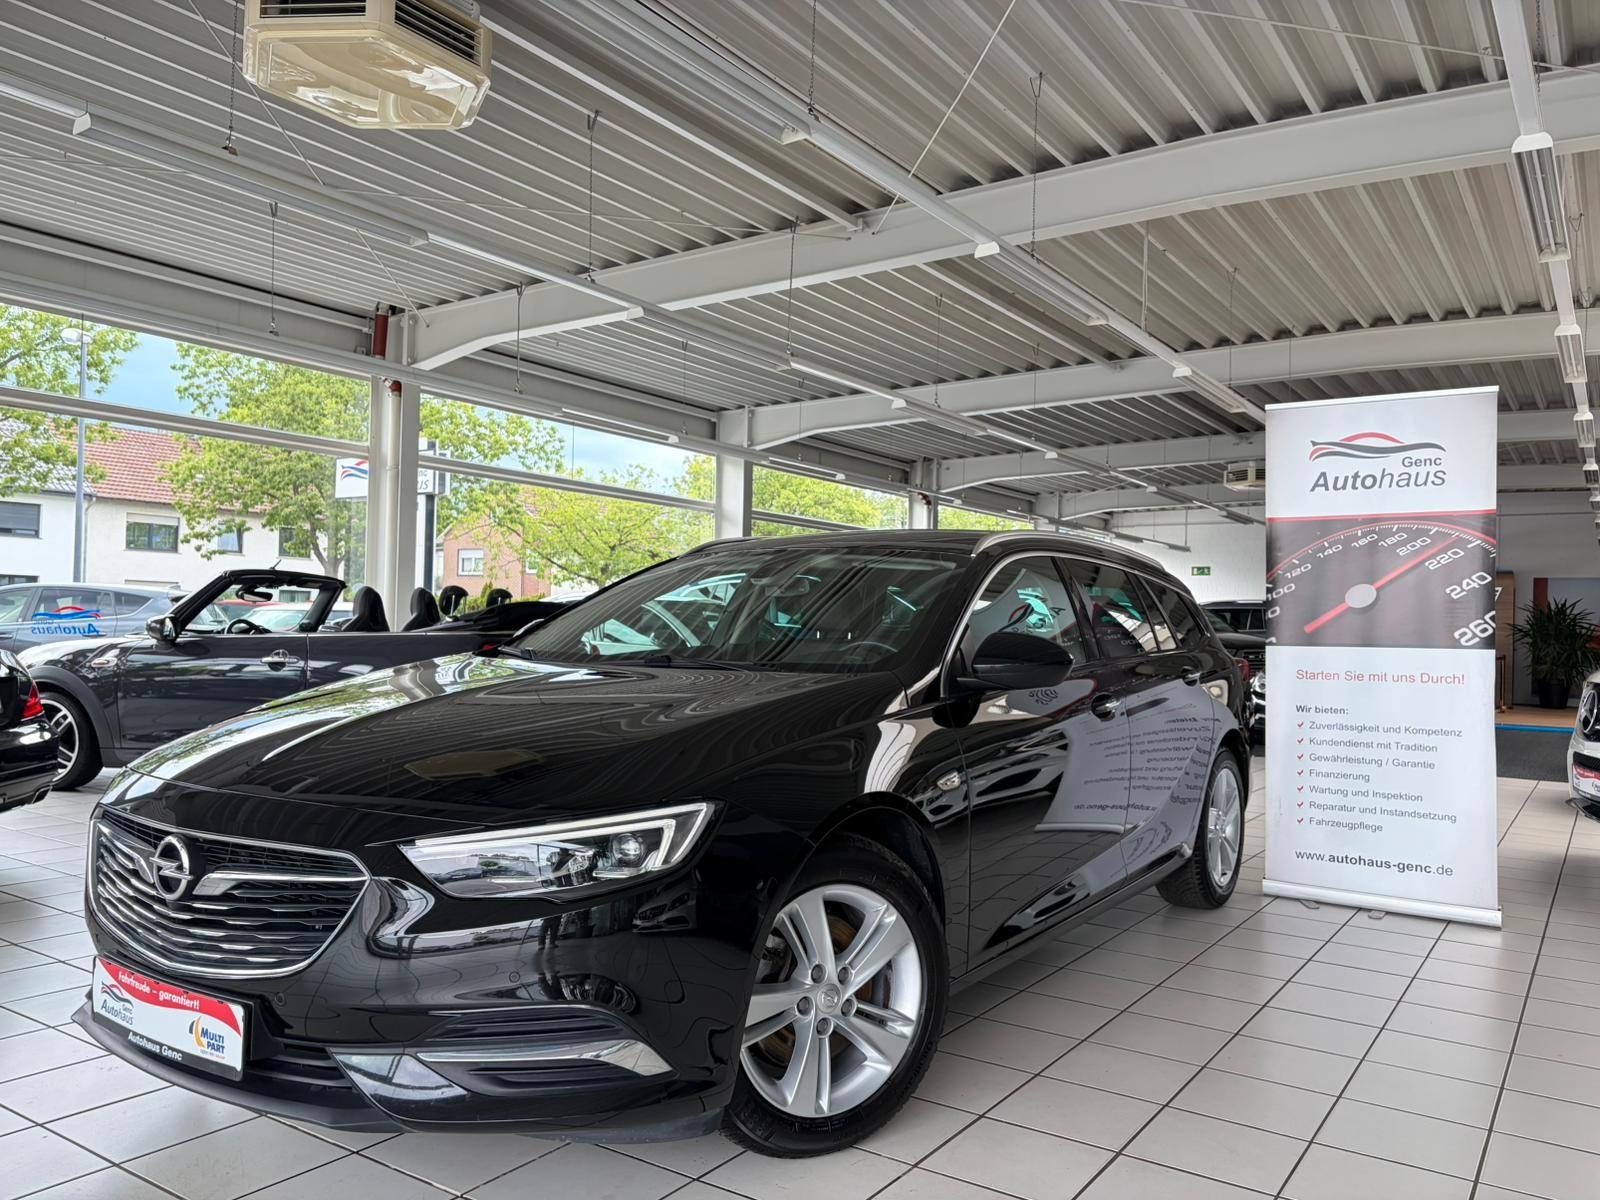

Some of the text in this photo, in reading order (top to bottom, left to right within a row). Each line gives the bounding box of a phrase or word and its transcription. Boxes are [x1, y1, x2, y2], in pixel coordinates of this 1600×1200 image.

[1401, 456, 1443, 468] Genc
[1309, 468, 1447, 493] Autohaus
[1351, 533, 1378, 548] 160
[1378, 532, 1408, 547] 180
[1396, 536, 1432, 556] 200
[1316, 544, 1343, 559] 140
[1424, 548, 1465, 570] 220
[1284, 563, 1312, 579] 120
[1266, 583, 1296, 600] 100
[1445, 571, 1492, 600] 240
[1296, 669, 1465, 685] Starten Sie mit uns Durch!
[1295, 705, 1349, 715] Wir bieten:
[1309, 721, 1463, 738] Zuverlässigkeit und Kompetenz
[1309, 737, 1438, 752] Kundendienst mit Tradition
[1309, 753, 1383, 768] Gewährleistung
[1391, 758, 1436, 770] Garantie
[1309, 769, 1370, 783] Finanzierung
[1309, 785, 1423, 802] Wartung und Inspektion
[1309, 801, 1457, 824] Reparatur und Instandsetzung
[1309, 817, 1383, 833] Fahrzeugpflege
[1295, 850, 1453, 877] www.autohaus-genc.de
[159, 990, 200, 1011] garantiert!
[101, 999, 134, 1026] Autohaus
[201, 1027, 225, 1044] MULTI
[128, 1031, 161, 1053] Autohaus
[161, 1045, 183, 1061] Genc
[207, 1041, 225, 1054] PART
